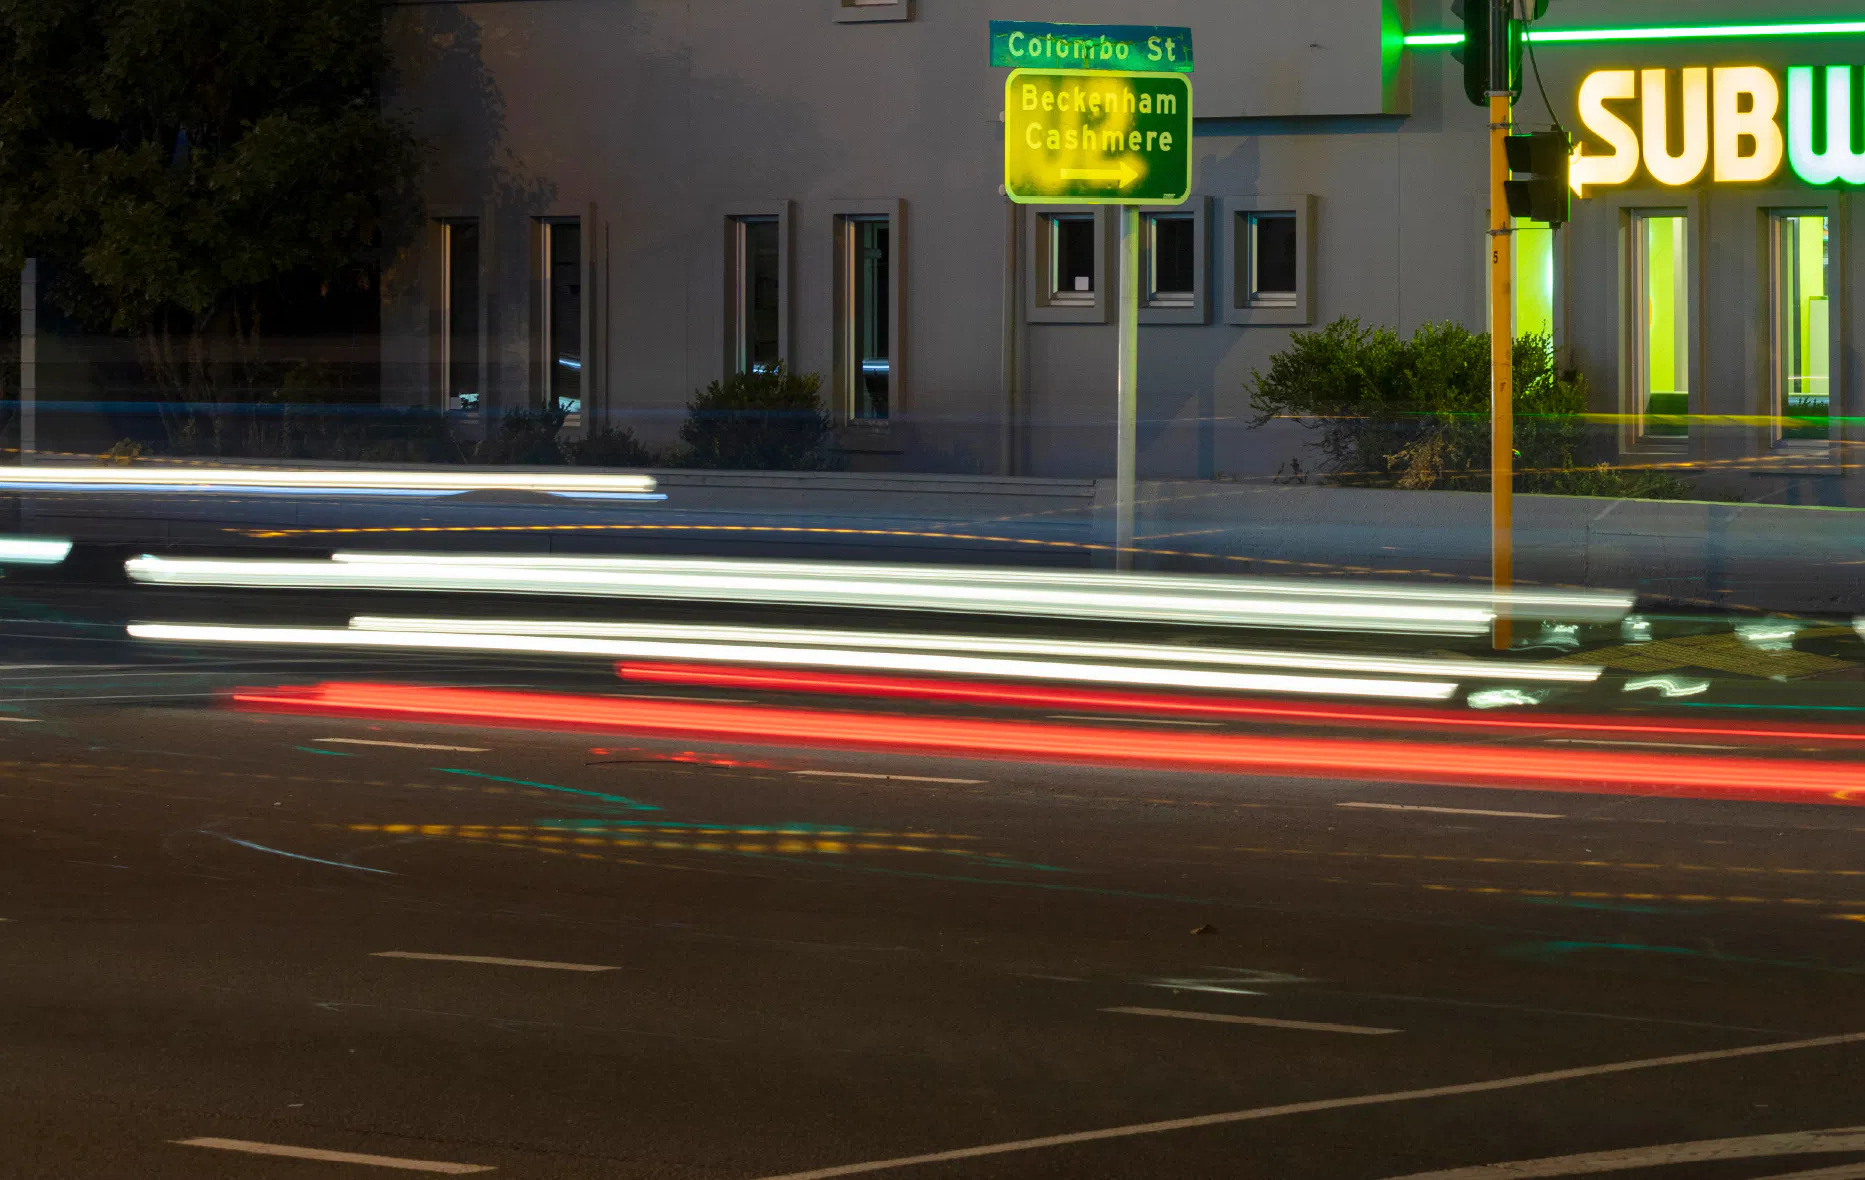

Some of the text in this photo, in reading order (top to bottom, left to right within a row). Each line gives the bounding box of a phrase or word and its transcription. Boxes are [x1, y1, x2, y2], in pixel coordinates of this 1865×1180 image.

[1008, 31, 1176, 62] Colombo St
[1021, 83, 1177, 115] Beckenham
[1025, 122, 1173, 152] Cashmere
